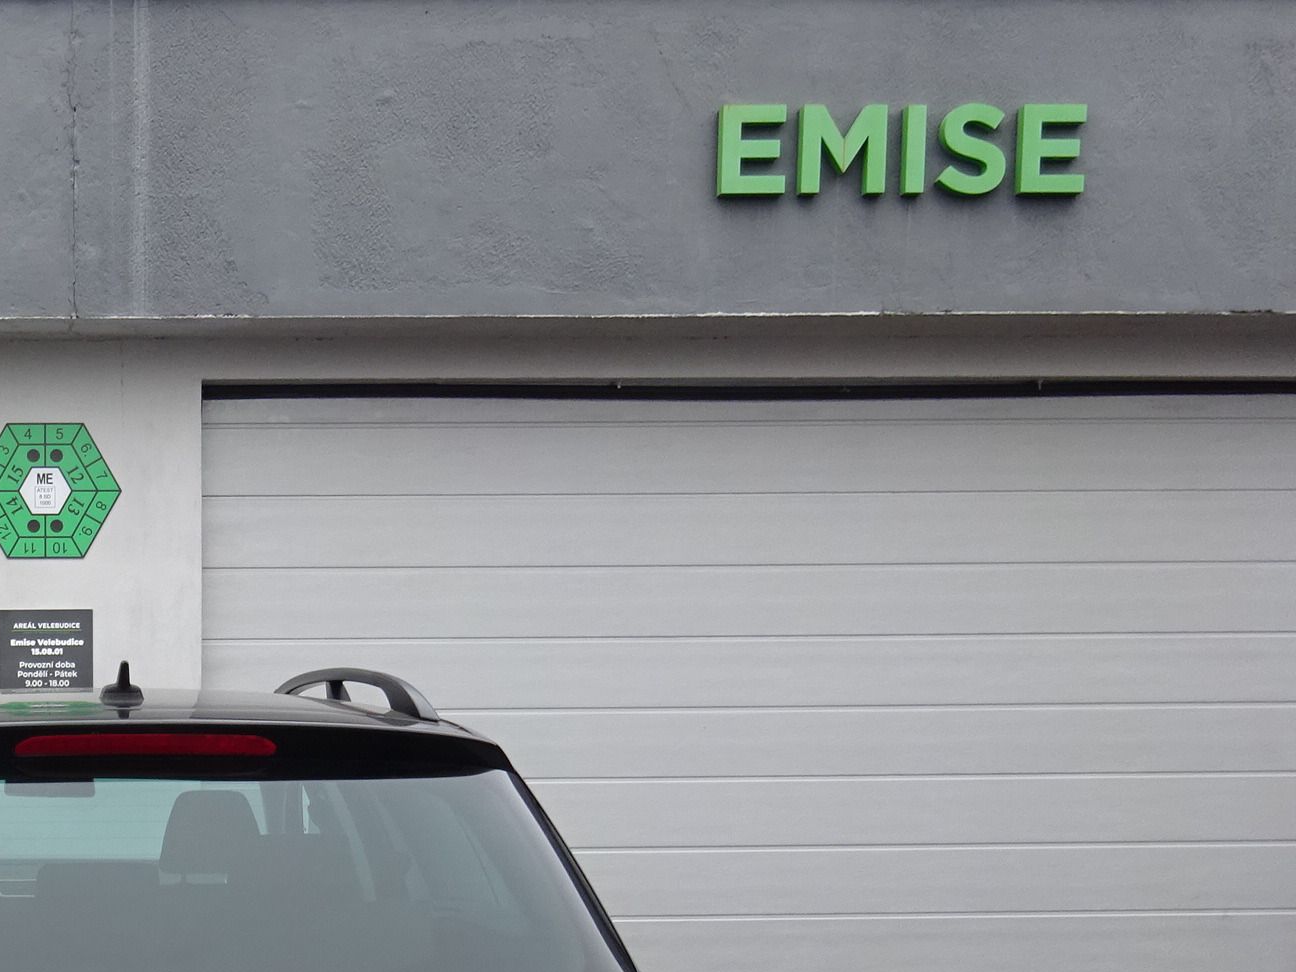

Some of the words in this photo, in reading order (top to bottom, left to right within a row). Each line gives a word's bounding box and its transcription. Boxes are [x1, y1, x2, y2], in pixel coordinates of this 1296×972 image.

[716, 104, 1088, 197] EMISE
[24, 428, 32, 440] 4
[56, 428, 64, 440] 5
[7, 465, 24, 484] 15
[36, 473, 53, 485] ME
[67, 466, 84, 484] 12
[96, 470, 108, 479] 7
[6, 497, 24, 515] 14
[67, 497, 85, 516] 13
[95, 501, 107, 511] 8
[24, 542, 36, 553] 11
[53, 542, 67, 554] 10
[13, 621, 36, 629] AREÁL
[10, 638, 36, 646] Emise
[37, 638, 84, 646] Velebudice
[19, 661, 54, 669] Provozní
[55, 661, 75, 669] doba
[17, 670, 48, 678] Pondělí
[54, 670, 78, 678] Pátek
